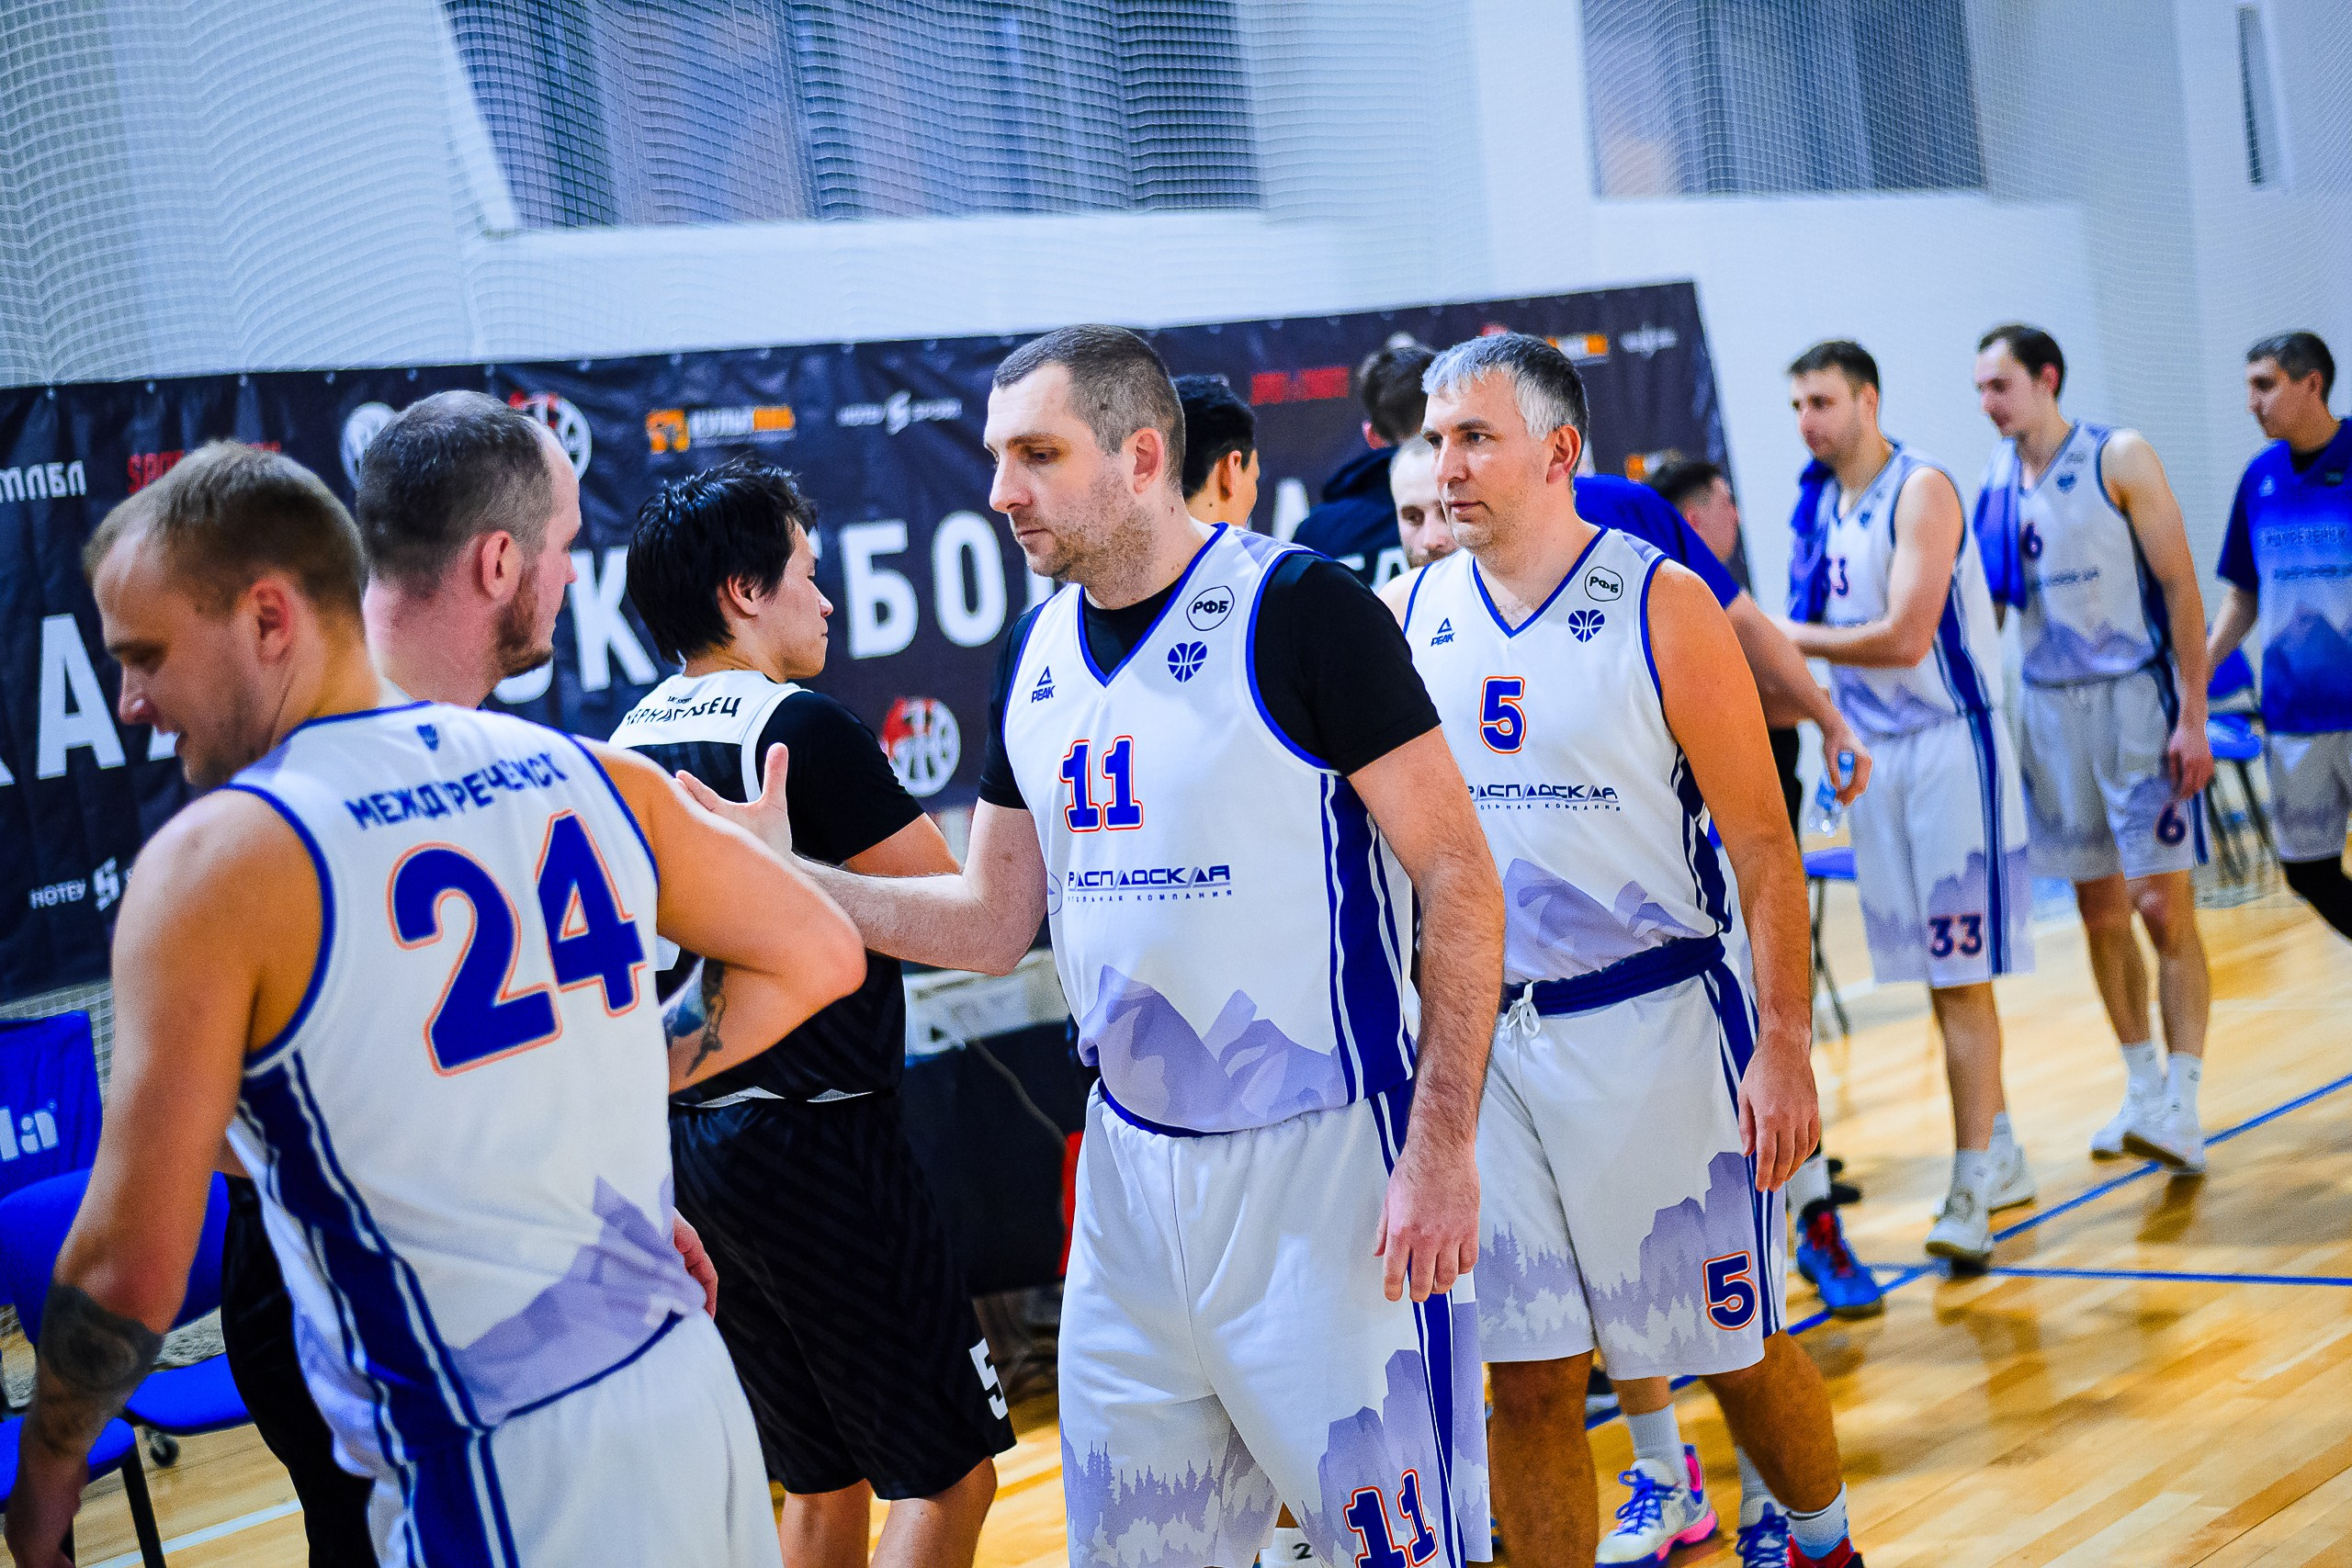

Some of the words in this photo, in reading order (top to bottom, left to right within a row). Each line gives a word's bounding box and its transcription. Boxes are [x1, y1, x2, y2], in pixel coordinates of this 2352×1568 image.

[1193, 600, 1229, 615] РФБ
[1589, 576, 1619, 593] РФБ
[1430, 632, 1455, 647] PEAK
[1031, 685, 1056, 704] PEAK
[1479, 675, 1527, 755] 5
[1058, 735, 1144, 833] 11
[2154, 799, 2187, 847] 6
[1136, 889, 1232, 901] КОМПАНИЯ
[384, 807, 648, 1079] 24
[1928, 912, 1983, 958] 33
[1702, 1250, 1758, 1331] 5
[969, 1337, 1009, 1420] 5
[1342, 1468, 1439, 1568] 11
[1293, 1542, 1313, 1561] 2
